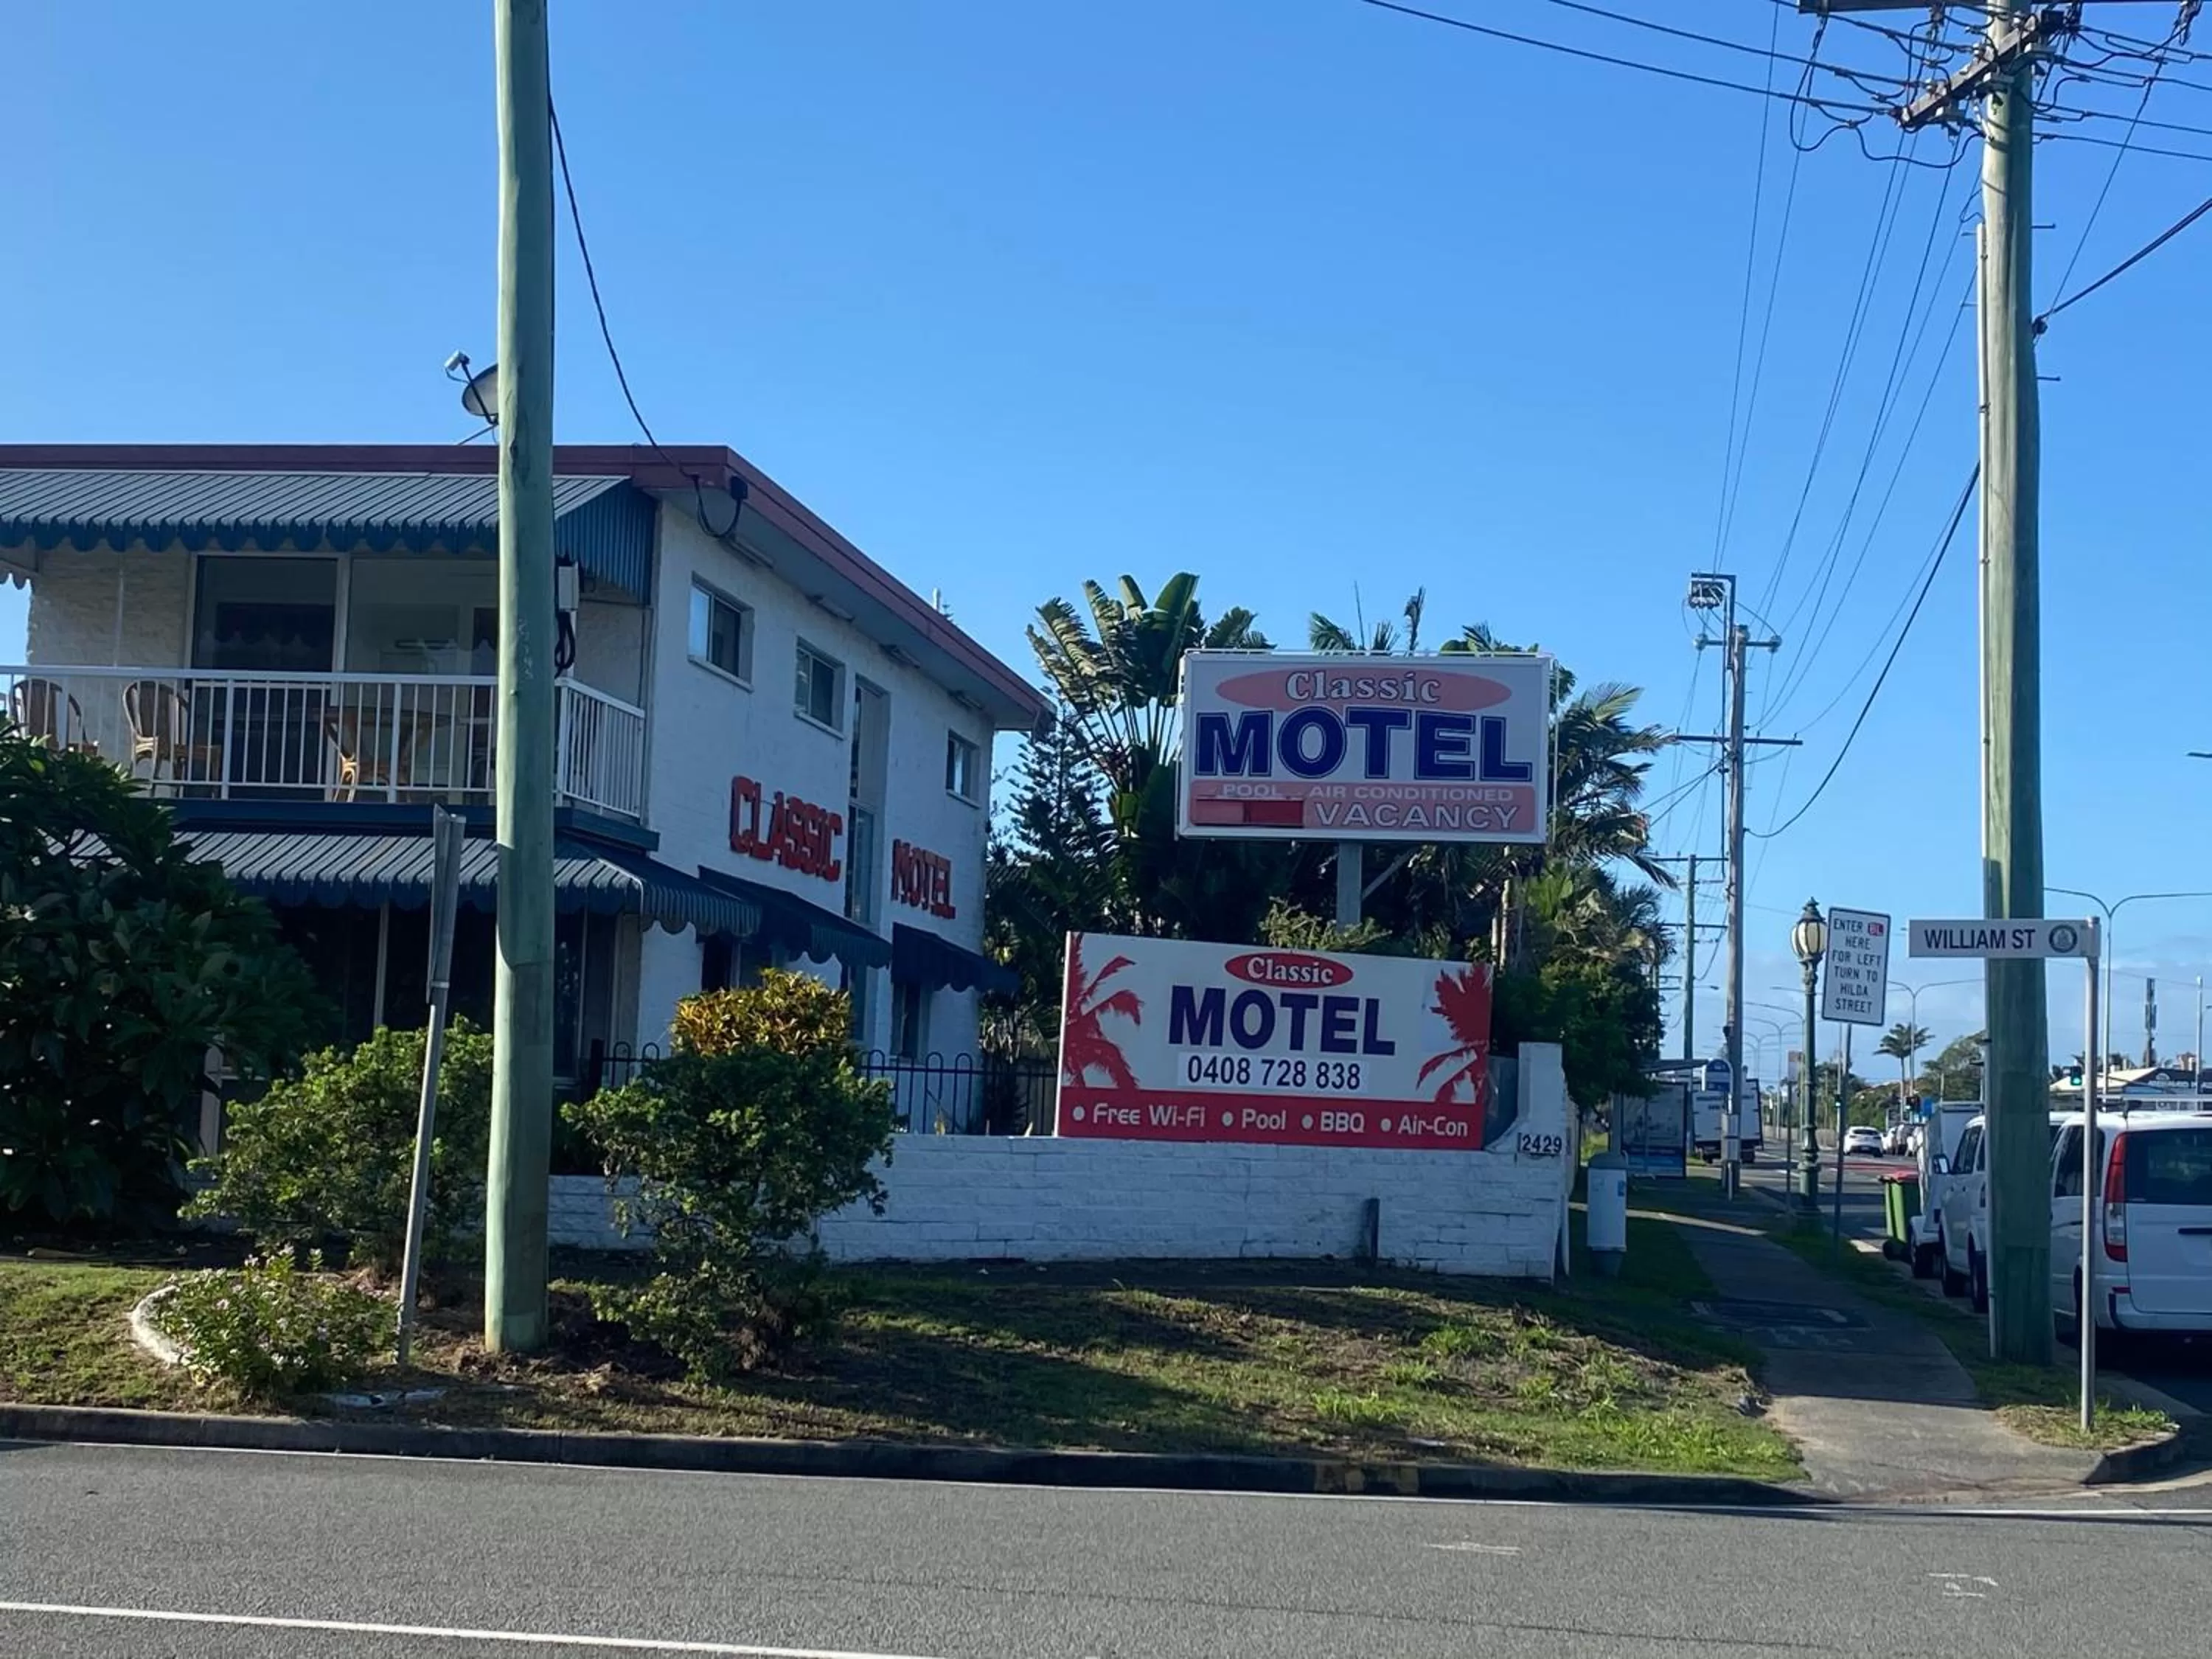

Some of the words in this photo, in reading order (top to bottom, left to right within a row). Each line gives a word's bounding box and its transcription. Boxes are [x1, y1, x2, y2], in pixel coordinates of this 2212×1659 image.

[1285, 672, 1441, 703] Classic
[1194, 706, 1533, 782] MOTEL
[1222, 783, 1282, 797] POOL
[1309, 785, 1346, 799] AIR
[1354, 786, 1514, 802] CONDITIONED
[1314, 802, 1519, 829] VACANCY
[730, 776, 844, 882] CLASSIC
[891, 838, 956, 919] MOTEL
[1833, 918, 1863, 933] ENTER
[1845, 936, 1871, 950] HERE
[1924, 928, 2006, 950] WILLIAM
[2011, 928, 2037, 950] ST
[1832, 949, 1851, 963] FOR
[1857, 953, 1882, 967] LEFT
[1246, 956, 1333, 984] Classic
[1834, 965, 1860, 980] TURN
[1867, 970, 1878, 983] TO
[1840, 983, 1868, 996] HILDA
[1834, 998, 1873, 1014] STREET
[1169, 984, 1397, 1056] MOTEL
[1188, 1055, 1251, 1085] 0408
[1261, 1058, 1307, 1088] 728
[1315, 1061, 1360, 1091] 838
[1148, 1104, 1206, 1128] Wi-Fi
[1241, 1108, 1287, 1130] Pool
[1320, 1111, 1365, 1133] BBQ
[1397, 1114, 1469, 1138] Air-Con
[1522, 1134, 1562, 1154] 2429
